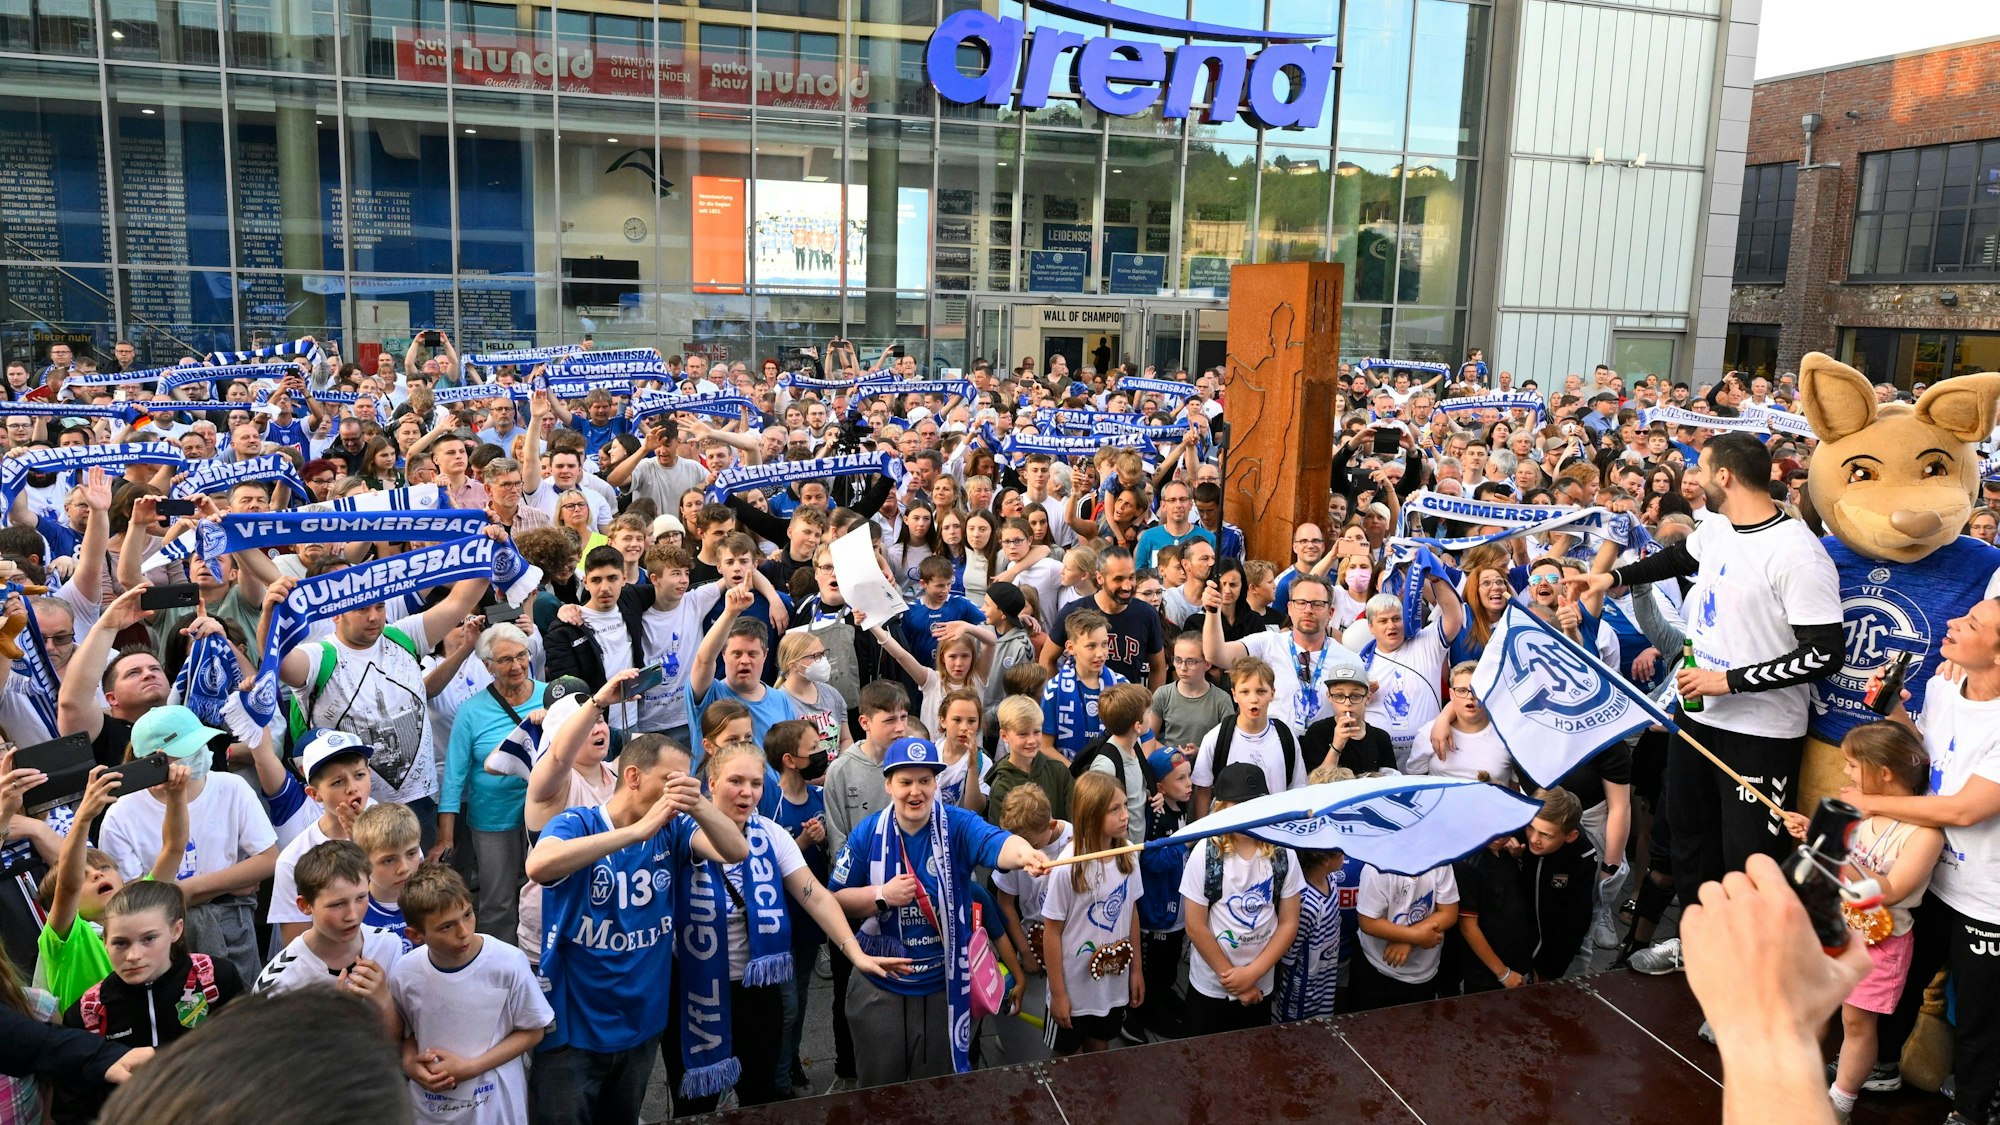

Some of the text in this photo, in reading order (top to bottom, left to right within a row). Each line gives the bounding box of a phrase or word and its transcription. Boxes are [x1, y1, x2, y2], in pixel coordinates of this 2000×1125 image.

[462, 39, 594, 79] hunold
[611, 55, 672, 70] STANDOTE
[611, 68, 638, 79] OLPE
[712, 62, 748, 76] auto
[927, 9, 1336, 128] arena
[712, 74, 748, 90] haus
[1048, 229, 1110, 243] LEIDENSCHT
[1044, 311, 1067, 322] WALL
[1069, 311, 1079, 322] OF
[34, 332, 93, 342] dieter nuhr
[486, 343, 514, 351] HELLO
[570, 362, 667, 376] GUMMERSBACH
[1016, 432, 1146, 448] GEMEINSAM STARK
[2, 442, 122, 485] GEMEINSAM
[63, 453, 139, 466] VFL GUMMERSBACH
[715, 452, 884, 488] GEMEINSAM STARK
[768, 469, 834, 484] VFL GUMMERSBACH
[234, 516, 489, 539] VFL GUMMERSBACH
[287, 538, 494, 615] GUMMERSBACH
[318, 578, 417, 615] GEMEINSAM STARK
[1861, 586, 1884, 597] VfL
[1058, 700, 1075, 740] VFL
[1735, 784, 1758, 804] 16
[616, 868, 653, 910] 13
[572, 915, 674, 952] MOELLR
[688, 978, 722, 1055] VfL
